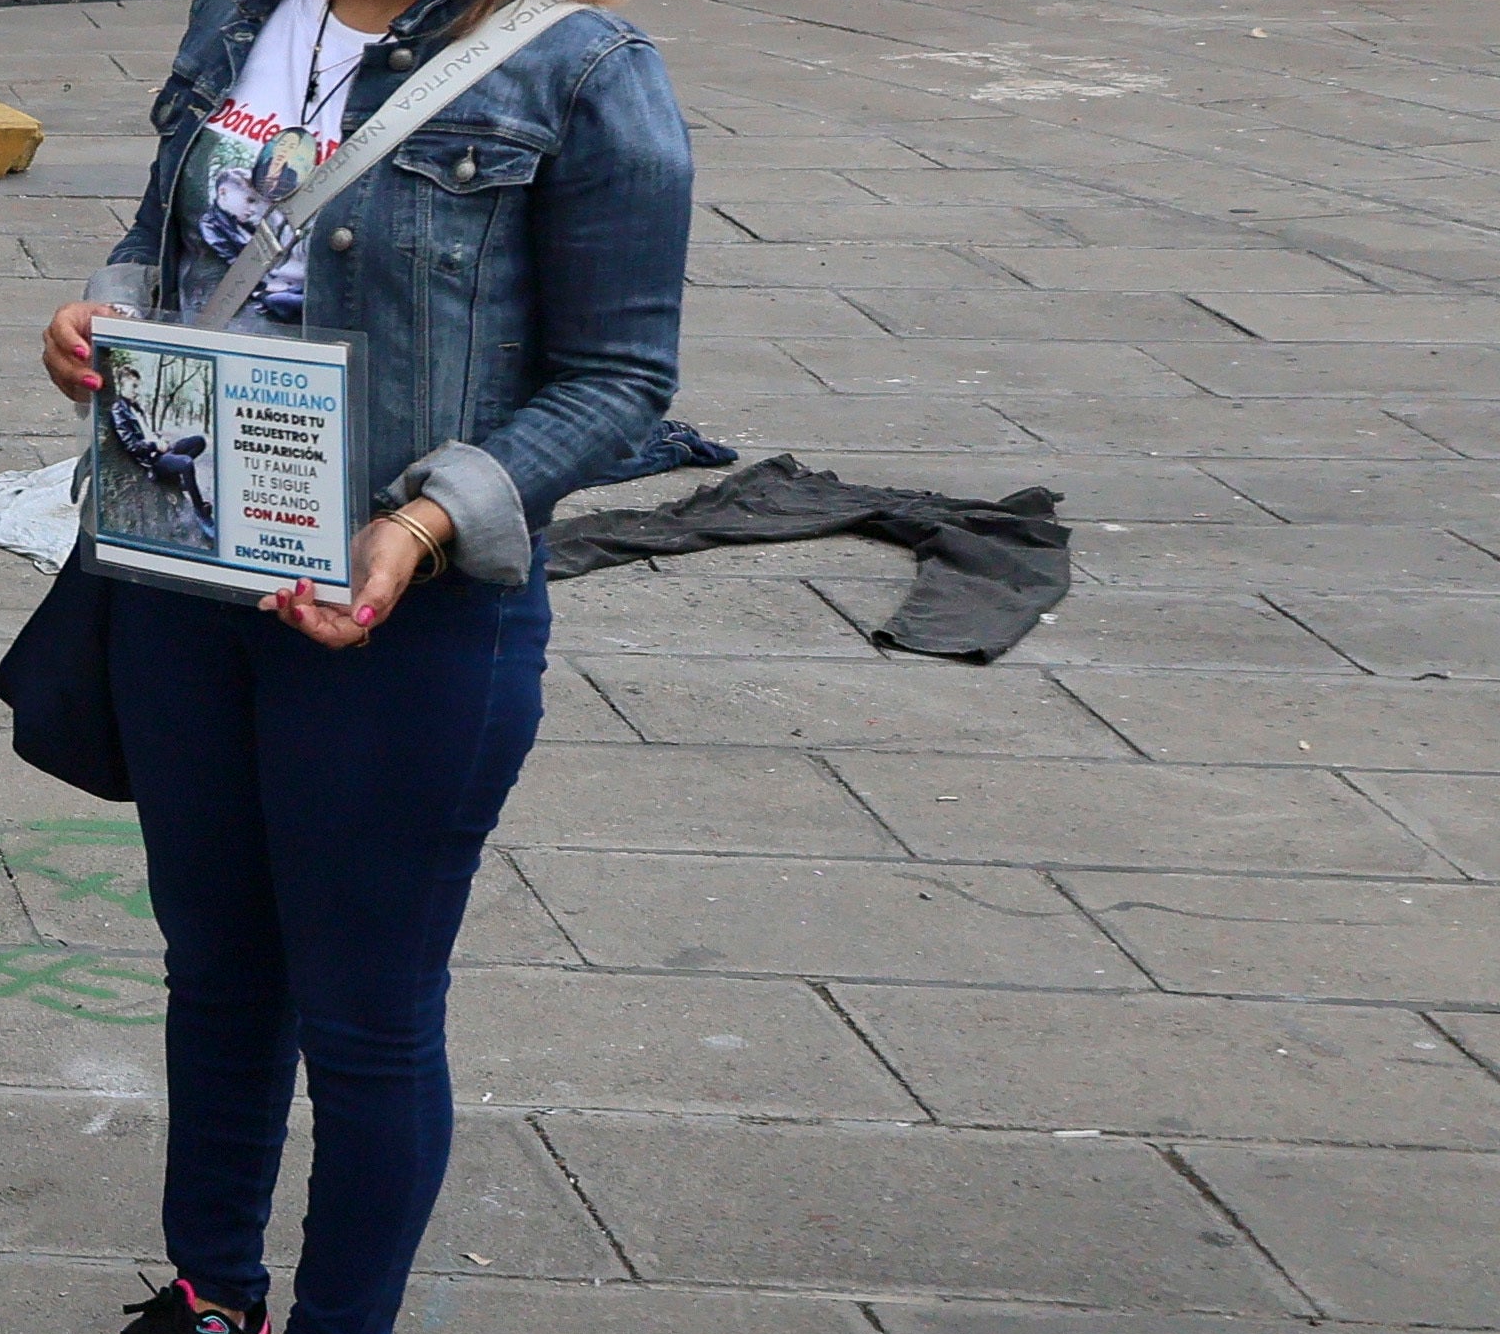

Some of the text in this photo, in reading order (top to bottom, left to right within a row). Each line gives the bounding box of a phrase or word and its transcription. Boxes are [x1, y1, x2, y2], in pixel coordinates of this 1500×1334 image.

[391, 40, 490, 111] NAUTICA
[251, 367, 308, 389] DIEGO
[224, 383, 336, 412] MAXIMILIANO
[235, 407, 245, 418] A
[255, 407, 290, 425] AÑOS
[291, 412, 306, 427] DE
[308, 416, 325, 429] TU
[241, 424, 319, 445] SECUESTRO Y
[243, 456, 318, 479] TU FAMILIA
[251, 474, 311, 495] TE SIGUE
[242, 489, 320, 512] BUSCANDO
[243, 506, 320, 529] CON AMOR.
[259, 533, 305, 552] HASTA
[235, 545, 332, 572] ENCONTRARTE
